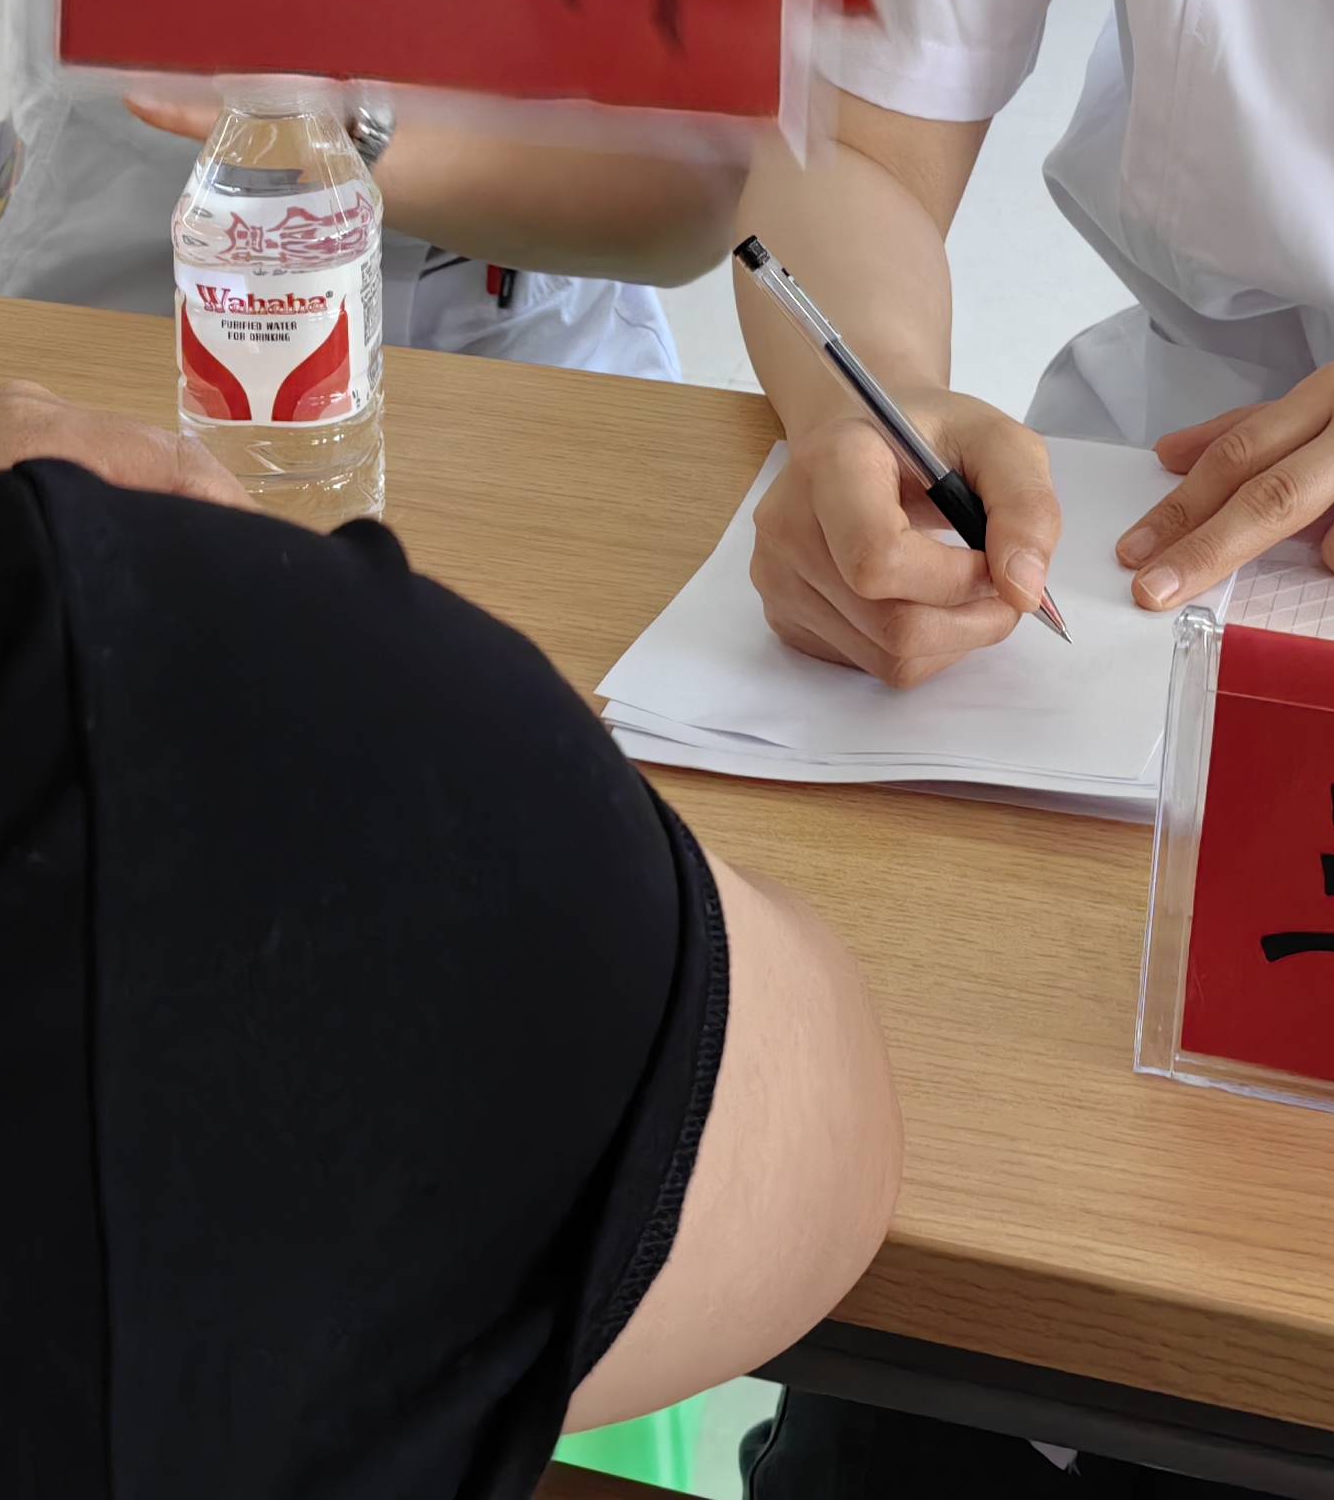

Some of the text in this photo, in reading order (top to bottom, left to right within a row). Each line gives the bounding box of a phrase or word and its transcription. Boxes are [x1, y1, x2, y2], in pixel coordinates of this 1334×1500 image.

[196, 284, 327, 315] Wahaha
[220, 318, 298, 332] PURIFIED WATER
[227, 331, 291, 343] FOR DRINKING
